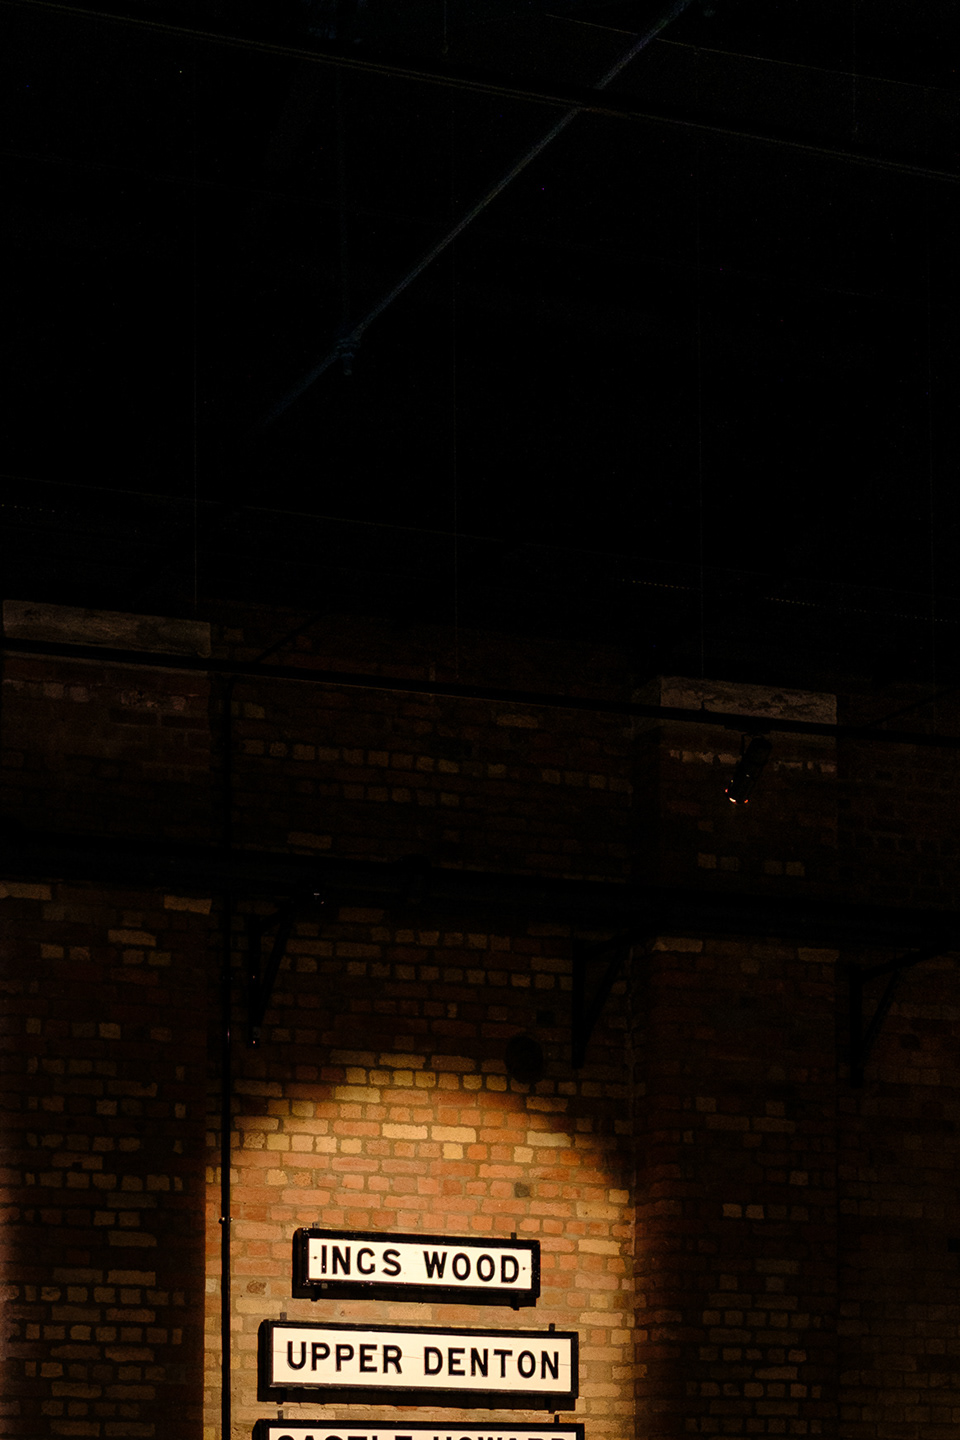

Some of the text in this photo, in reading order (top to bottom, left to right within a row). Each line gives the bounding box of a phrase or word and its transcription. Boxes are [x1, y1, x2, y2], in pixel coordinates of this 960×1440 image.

[320, 1244, 520, 1284] INGS WOOD
[286, 1340, 560, 1380] UPPER DENTON
